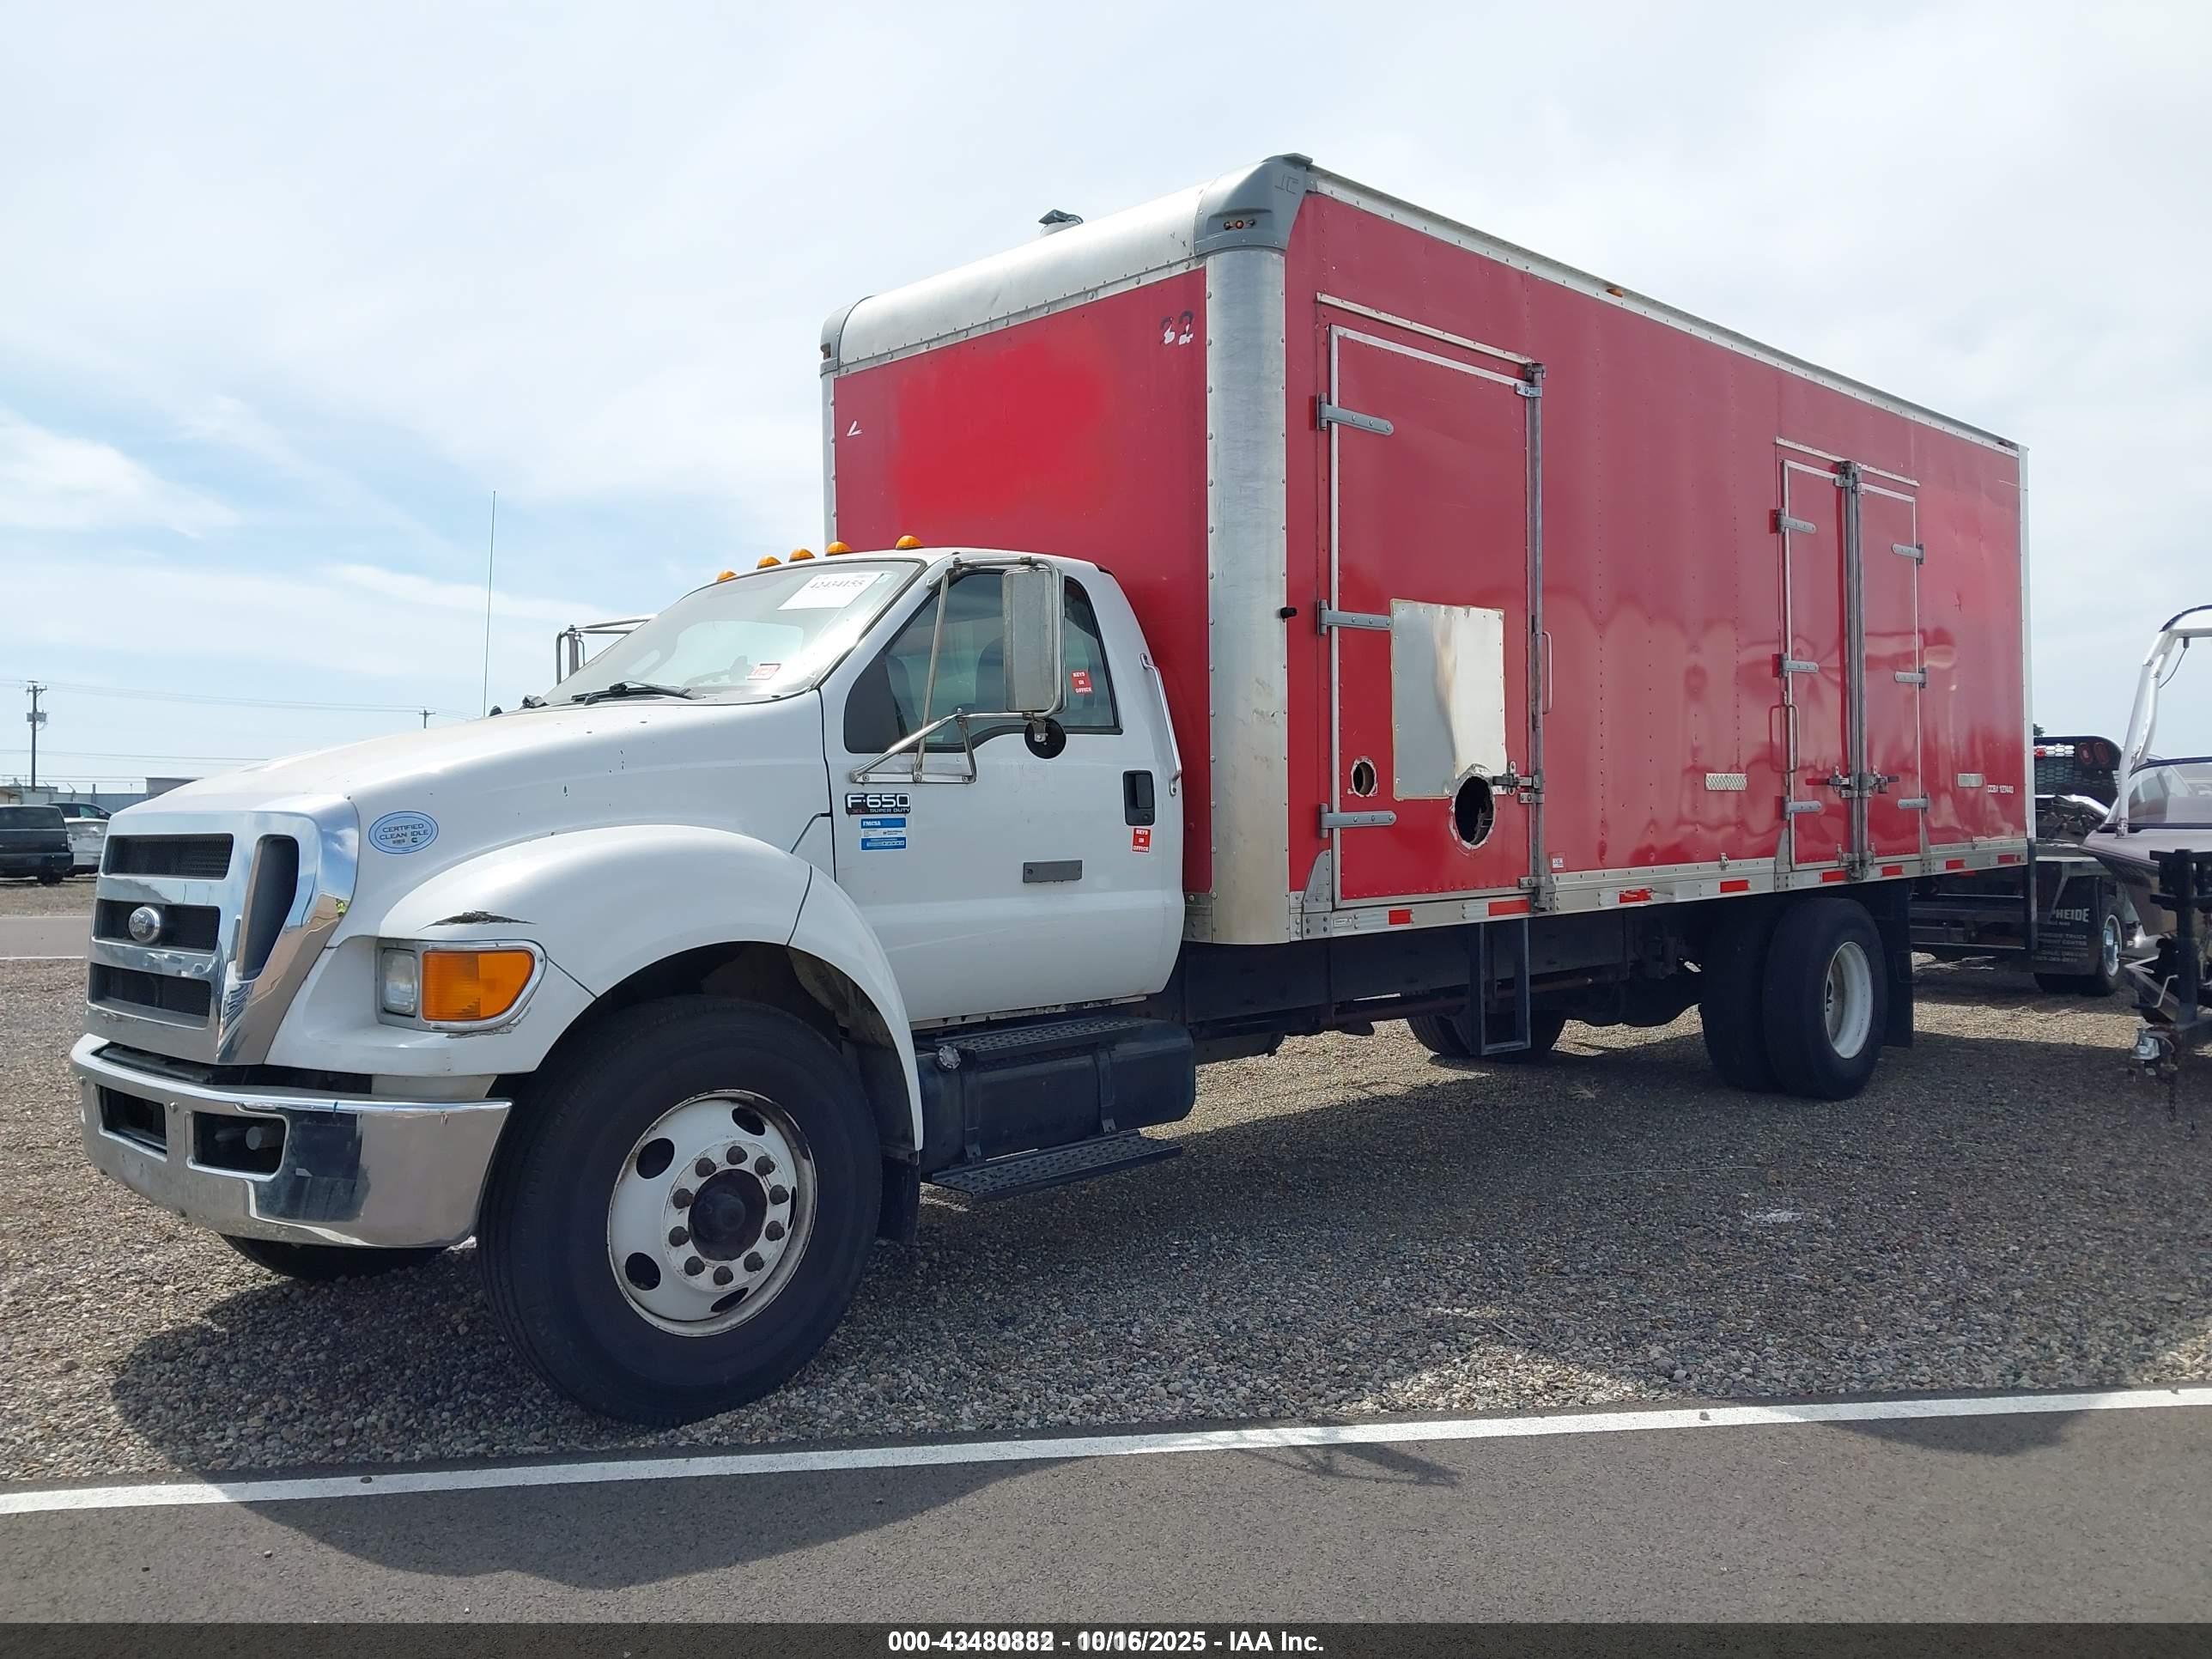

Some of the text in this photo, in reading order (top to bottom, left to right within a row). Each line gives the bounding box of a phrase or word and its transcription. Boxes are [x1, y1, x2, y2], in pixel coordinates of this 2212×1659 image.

[382, 823, 424, 833] CERTIFIED
[379, 829, 429, 841] CLEAN IDLE
[2053, 908, 2090, 923] HEIDE
